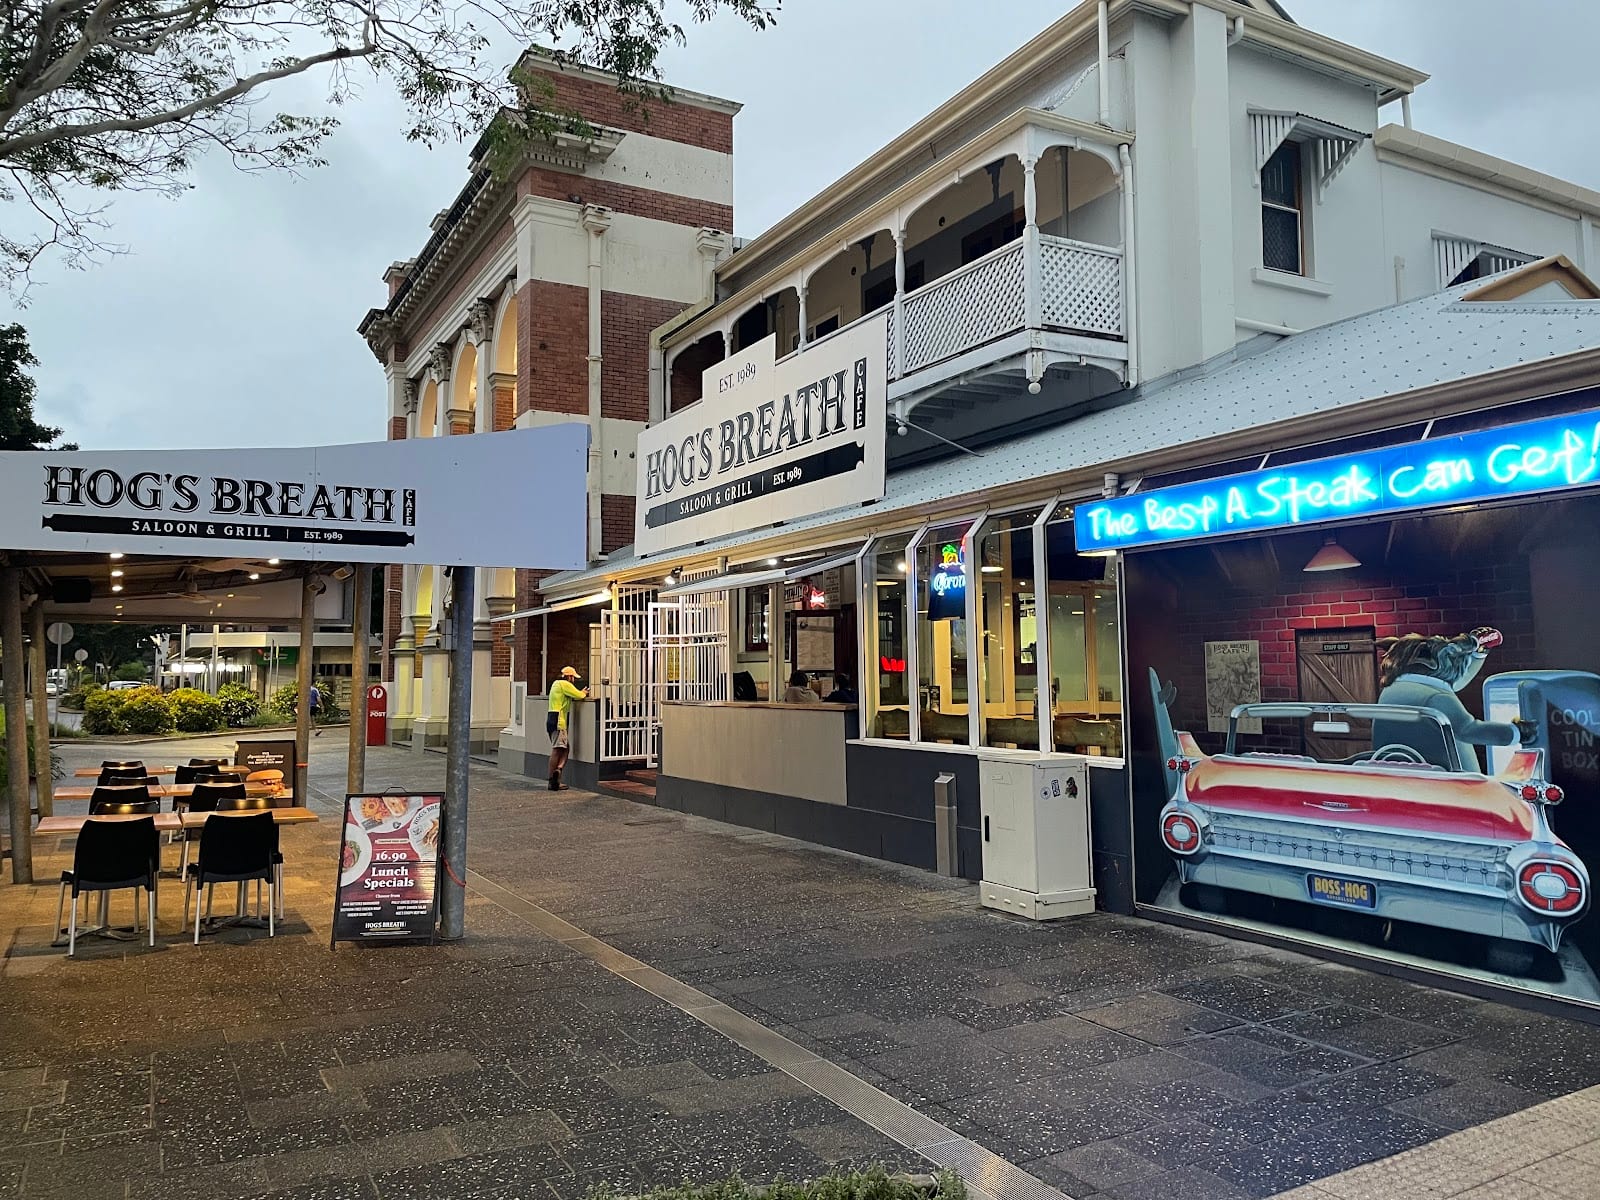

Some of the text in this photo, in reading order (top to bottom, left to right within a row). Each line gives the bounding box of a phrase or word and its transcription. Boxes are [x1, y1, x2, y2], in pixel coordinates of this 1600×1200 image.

[719, 362, 756, 394] EST. 1989
[855, 361, 864, 428] CAFE
[645, 368, 848, 500] HOG'S BREATH
[42, 465, 397, 524] HOG'S BREATH
[680, 466, 802, 515] SALOON & GRILL EST. 1989
[1087, 507, 1139, 541] The
[1144, 495, 1217, 532] Best
[1225, 486, 1251, 524] A
[1252, 464, 1379, 523] Steak
[1388, 458, 1475, 498] Can
[404, 489, 414, 526] CAFE
[132, 520, 343, 541] SALOON & GRILL EST. 1989
[933, 572, 966, 597] Coron
[1551, 708, 1600, 726] COOL
[1561, 730, 1594, 748] TIN
[1561, 751, 1600, 770] BOX
[375, 851, 408, 863] 16.90
[363, 877, 415, 890] Specials
[371, 865, 409, 877] Lunch
